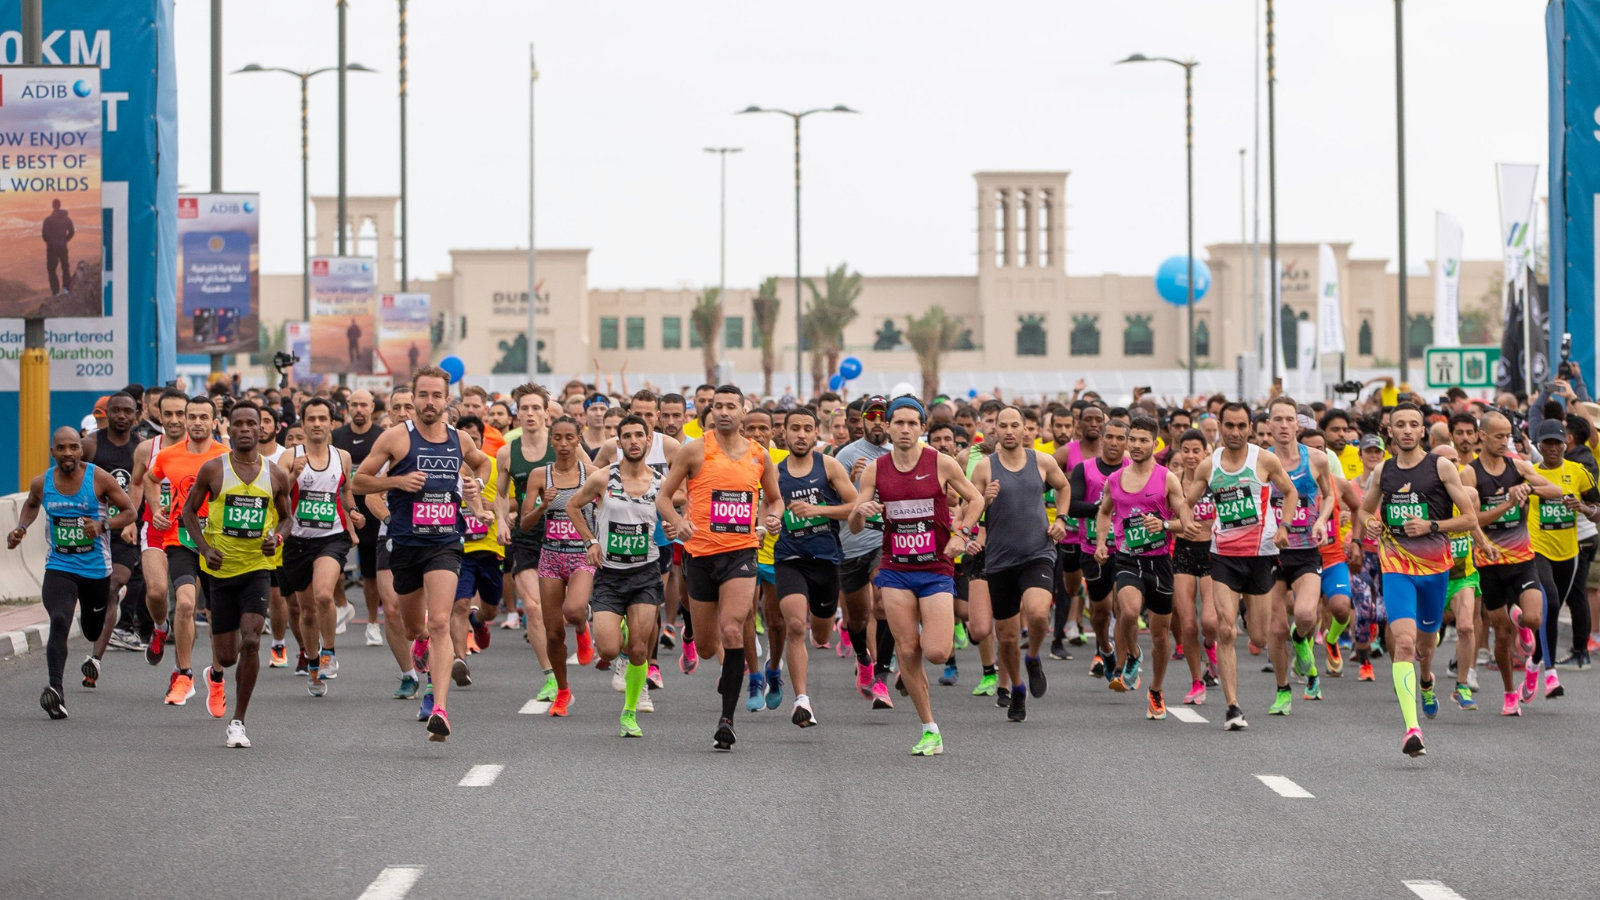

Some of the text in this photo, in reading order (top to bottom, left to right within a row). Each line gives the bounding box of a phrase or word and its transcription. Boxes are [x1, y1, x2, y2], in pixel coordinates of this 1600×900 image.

[21, 84, 68, 99] ADIB
[30, 131, 88, 150] ENJOY
[16, 154, 58, 169] BEST
[63, 154, 87, 169] OF
[10, 177, 89, 192] WORLDS
[210, 203, 240, 214] ADIB
[76, 363, 114, 377] 2020
[228, 507, 264, 523] 13421
[300, 501, 334, 516] 12665
[416, 504, 454, 519] 21500
[713, 502, 751, 518] 10005
[893, 506, 934, 516] SARADAR
[1219, 498, 1255, 517] 22474
[1389, 505, 1424, 519] 19818
[57, 527, 89, 541] 1248
[549, 521, 577, 534] 2150
[1127, 526, 1161, 541] 127
[610, 534, 646, 549] 21473
[893, 532, 932, 548] 10007
